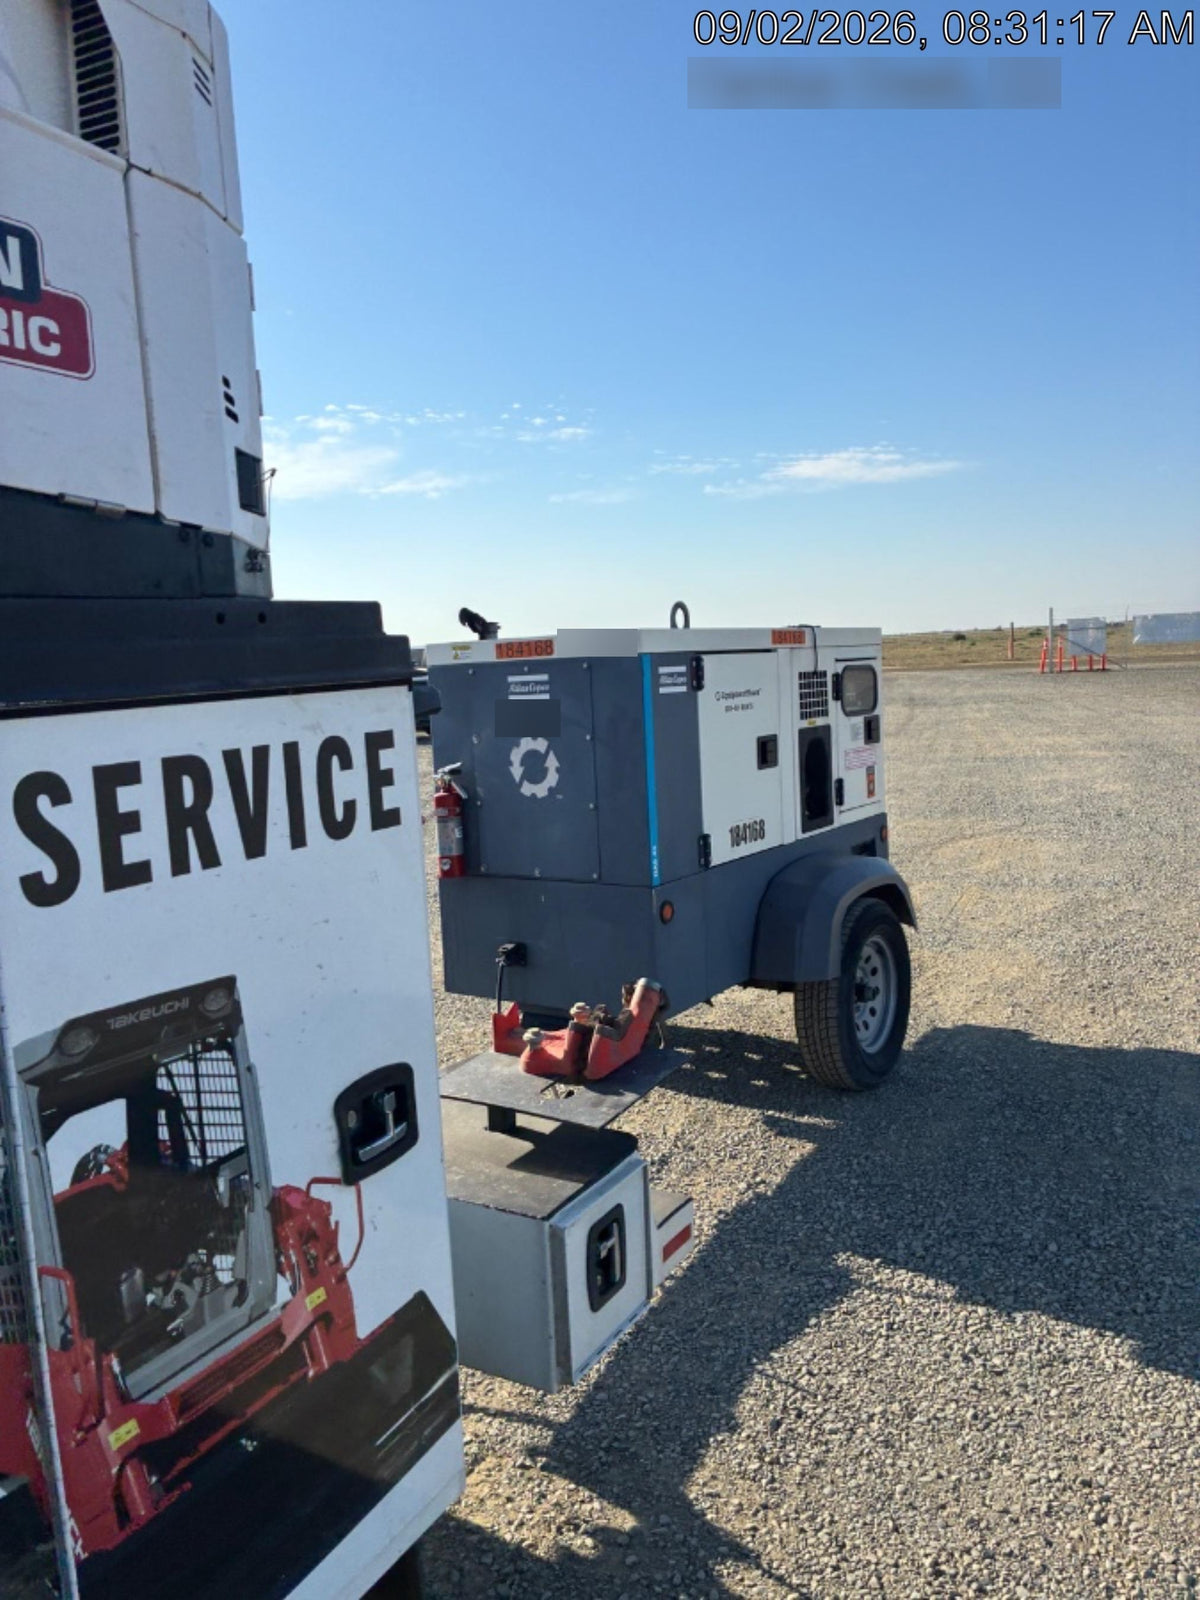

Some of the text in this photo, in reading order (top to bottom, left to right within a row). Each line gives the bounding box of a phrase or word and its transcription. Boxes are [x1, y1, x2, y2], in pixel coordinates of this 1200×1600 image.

[496, 640, 554, 659] 184168
[12, 729, 401, 908] SERVICE
[728, 818, 765, 848] 184168
